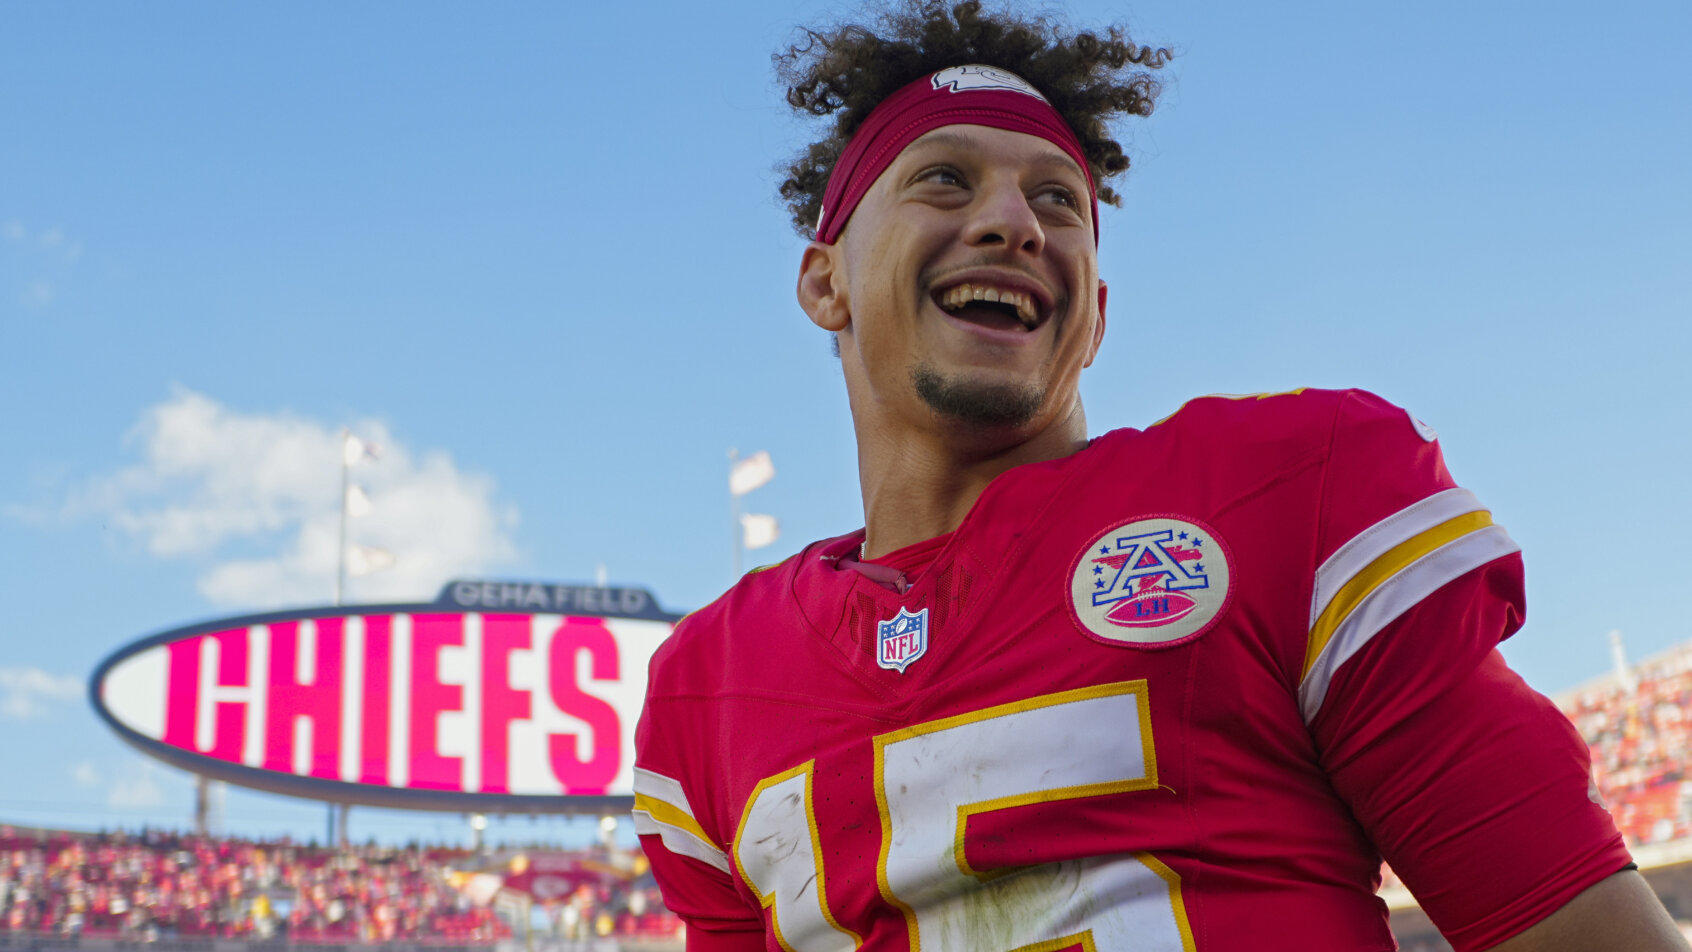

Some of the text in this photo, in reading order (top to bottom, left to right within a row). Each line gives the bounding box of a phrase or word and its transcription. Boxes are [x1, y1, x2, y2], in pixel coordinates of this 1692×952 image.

[453, 582, 647, 613] GEHA FIELD
[1133, 598, 1170, 617] LH
[885, 633, 918, 660] NFL
[163, 612, 622, 796] CHIEFS
[732, 679, 1197, 952] 15
